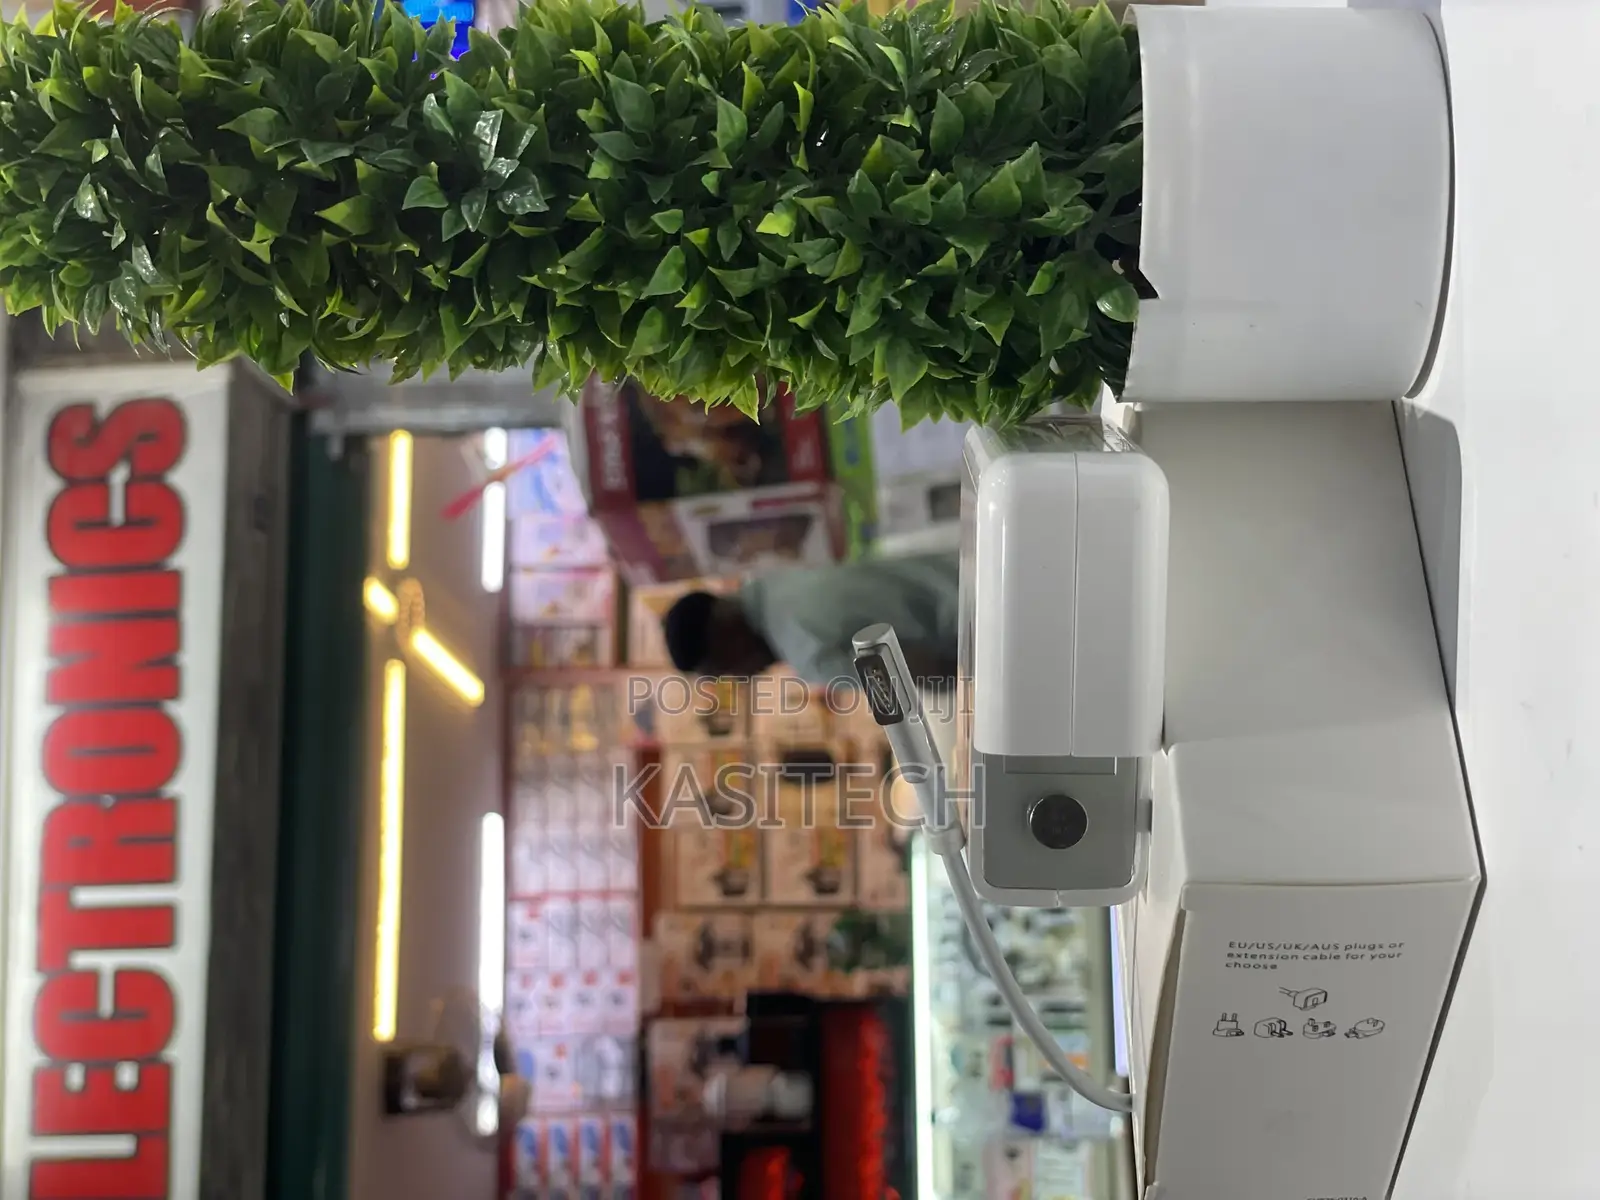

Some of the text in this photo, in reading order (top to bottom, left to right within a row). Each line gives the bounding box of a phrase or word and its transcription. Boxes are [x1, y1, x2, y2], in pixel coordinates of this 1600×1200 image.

[1228, 941, 1405, 951] EU/US/UK/AUS plugs or
[1226, 951, 1403, 961] extension cable for your
[1225, 961, 1278, 970] choose
